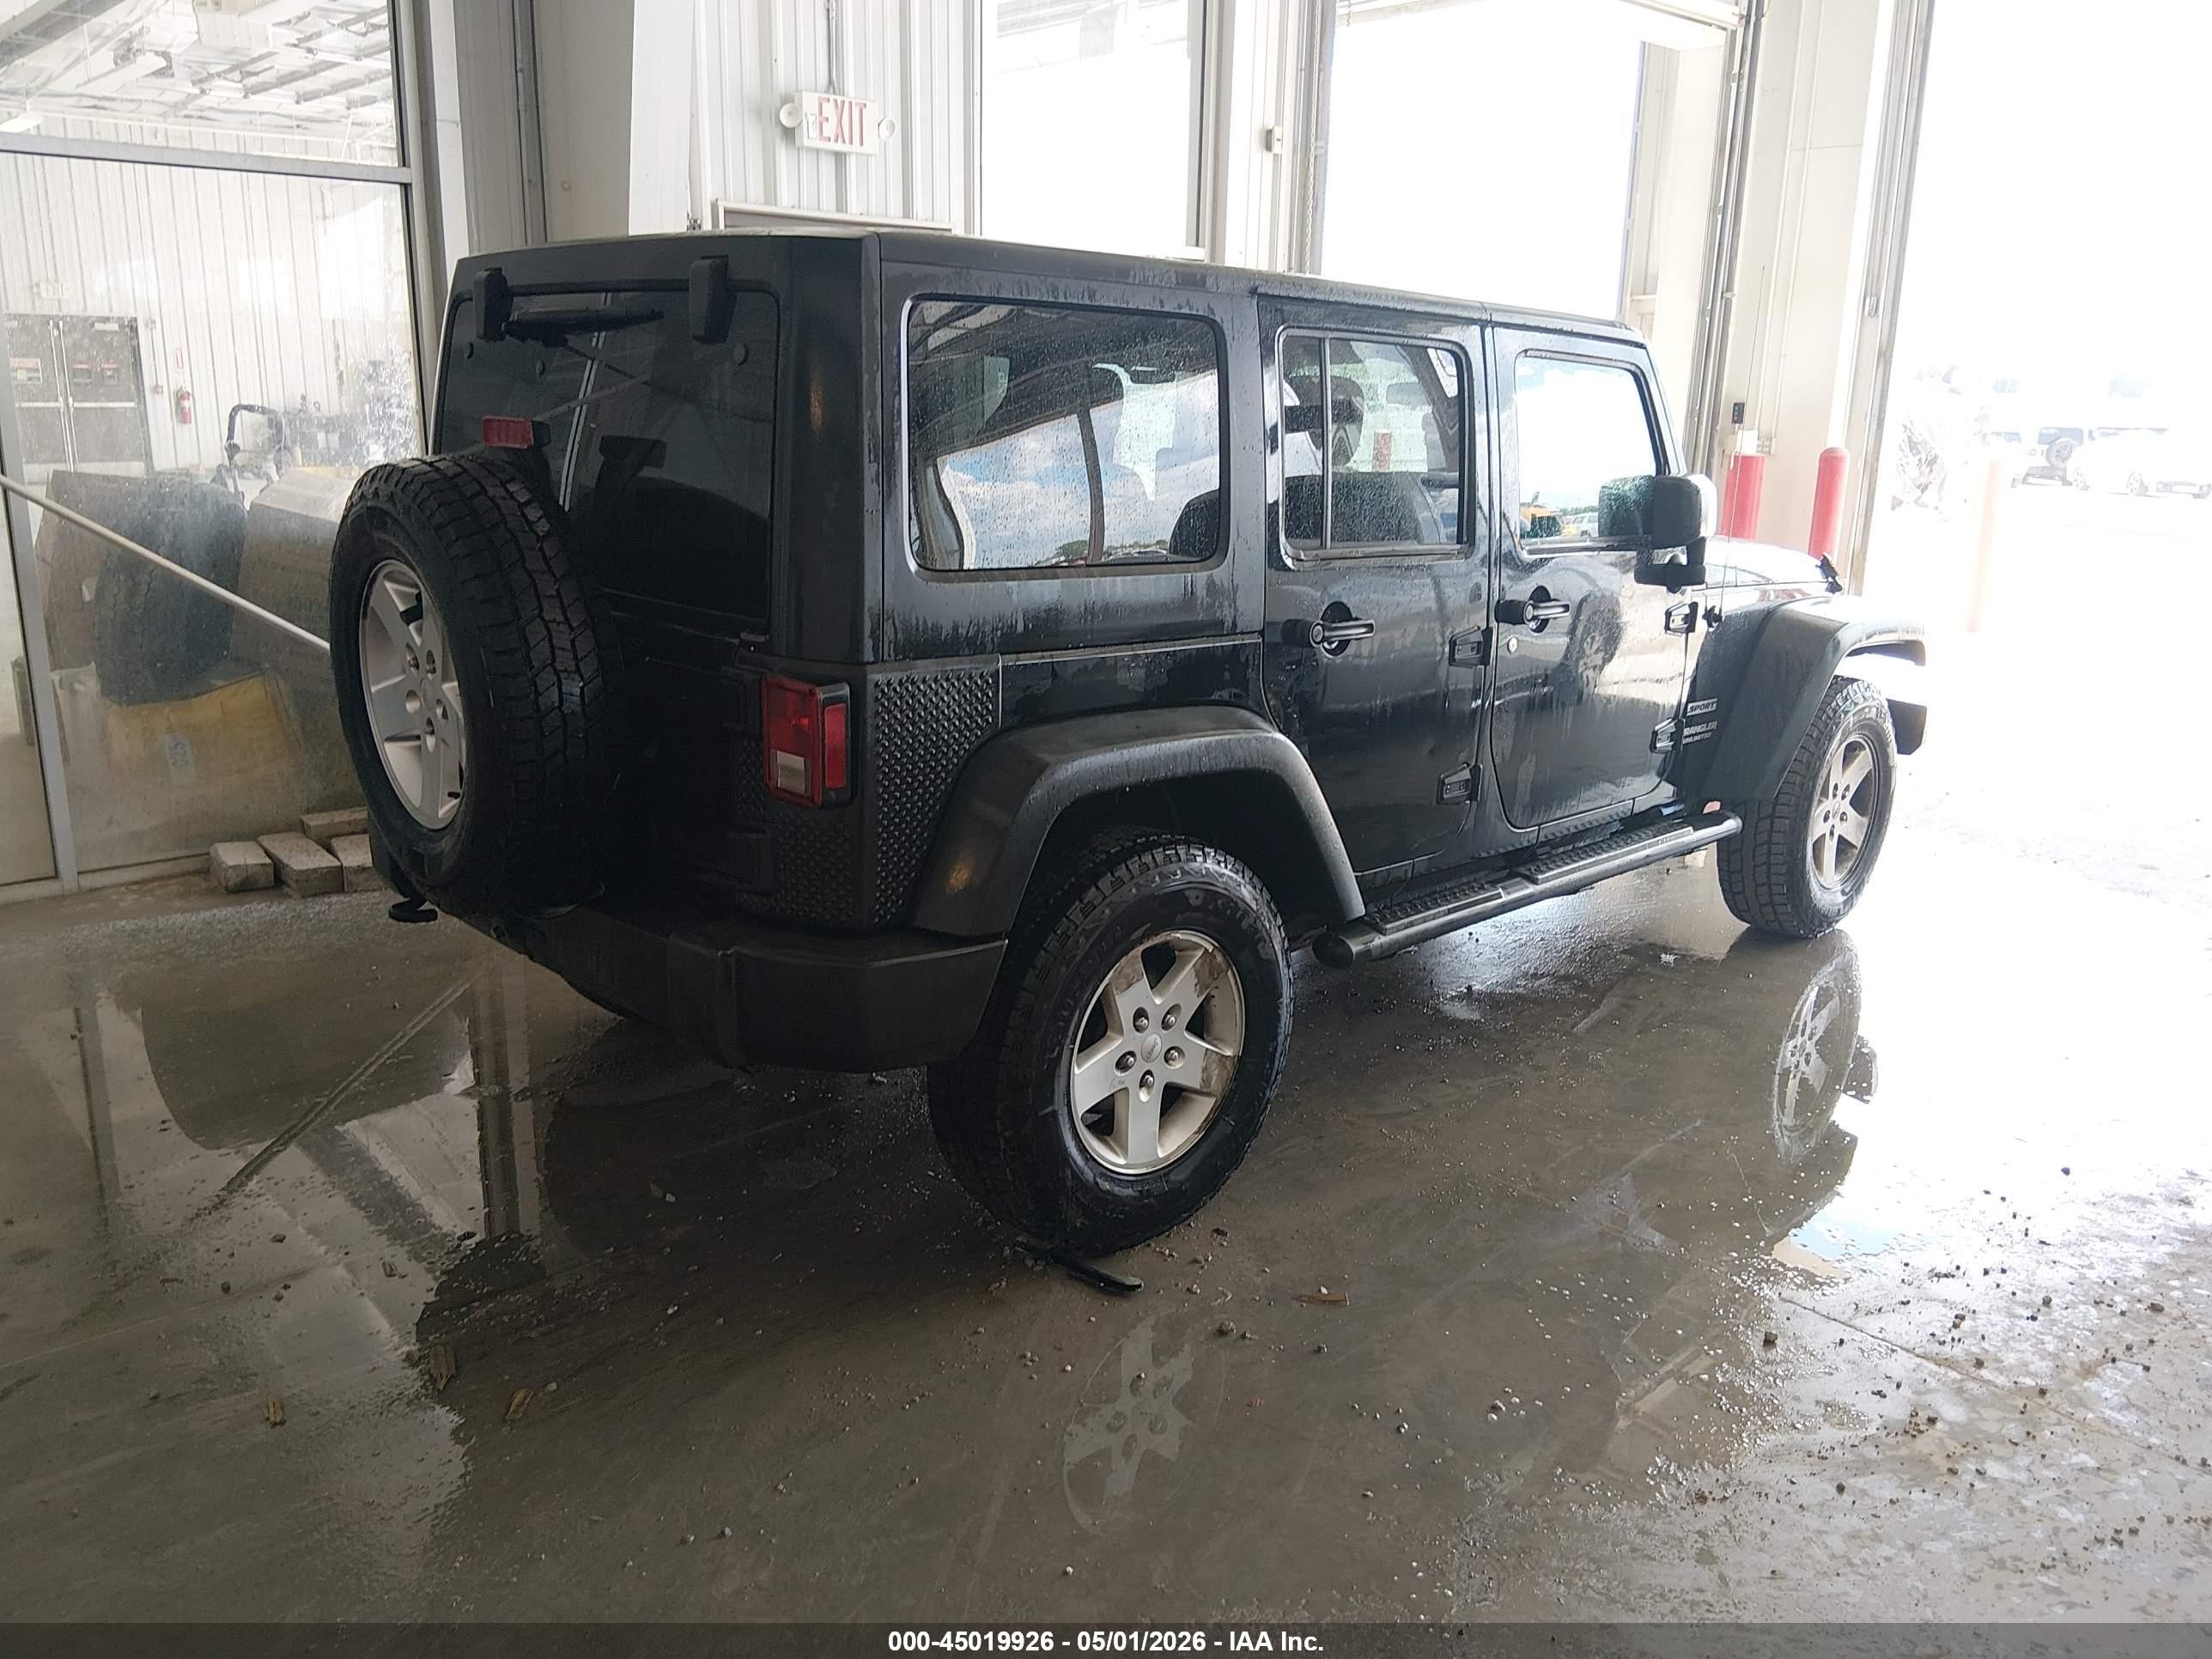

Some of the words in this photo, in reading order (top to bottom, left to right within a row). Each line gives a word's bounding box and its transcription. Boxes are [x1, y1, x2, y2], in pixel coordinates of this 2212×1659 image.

[817, 95, 866, 147] EXIT
[1688, 701, 1716, 714] SPORT
[1683, 721, 1717, 736] RANGLER
